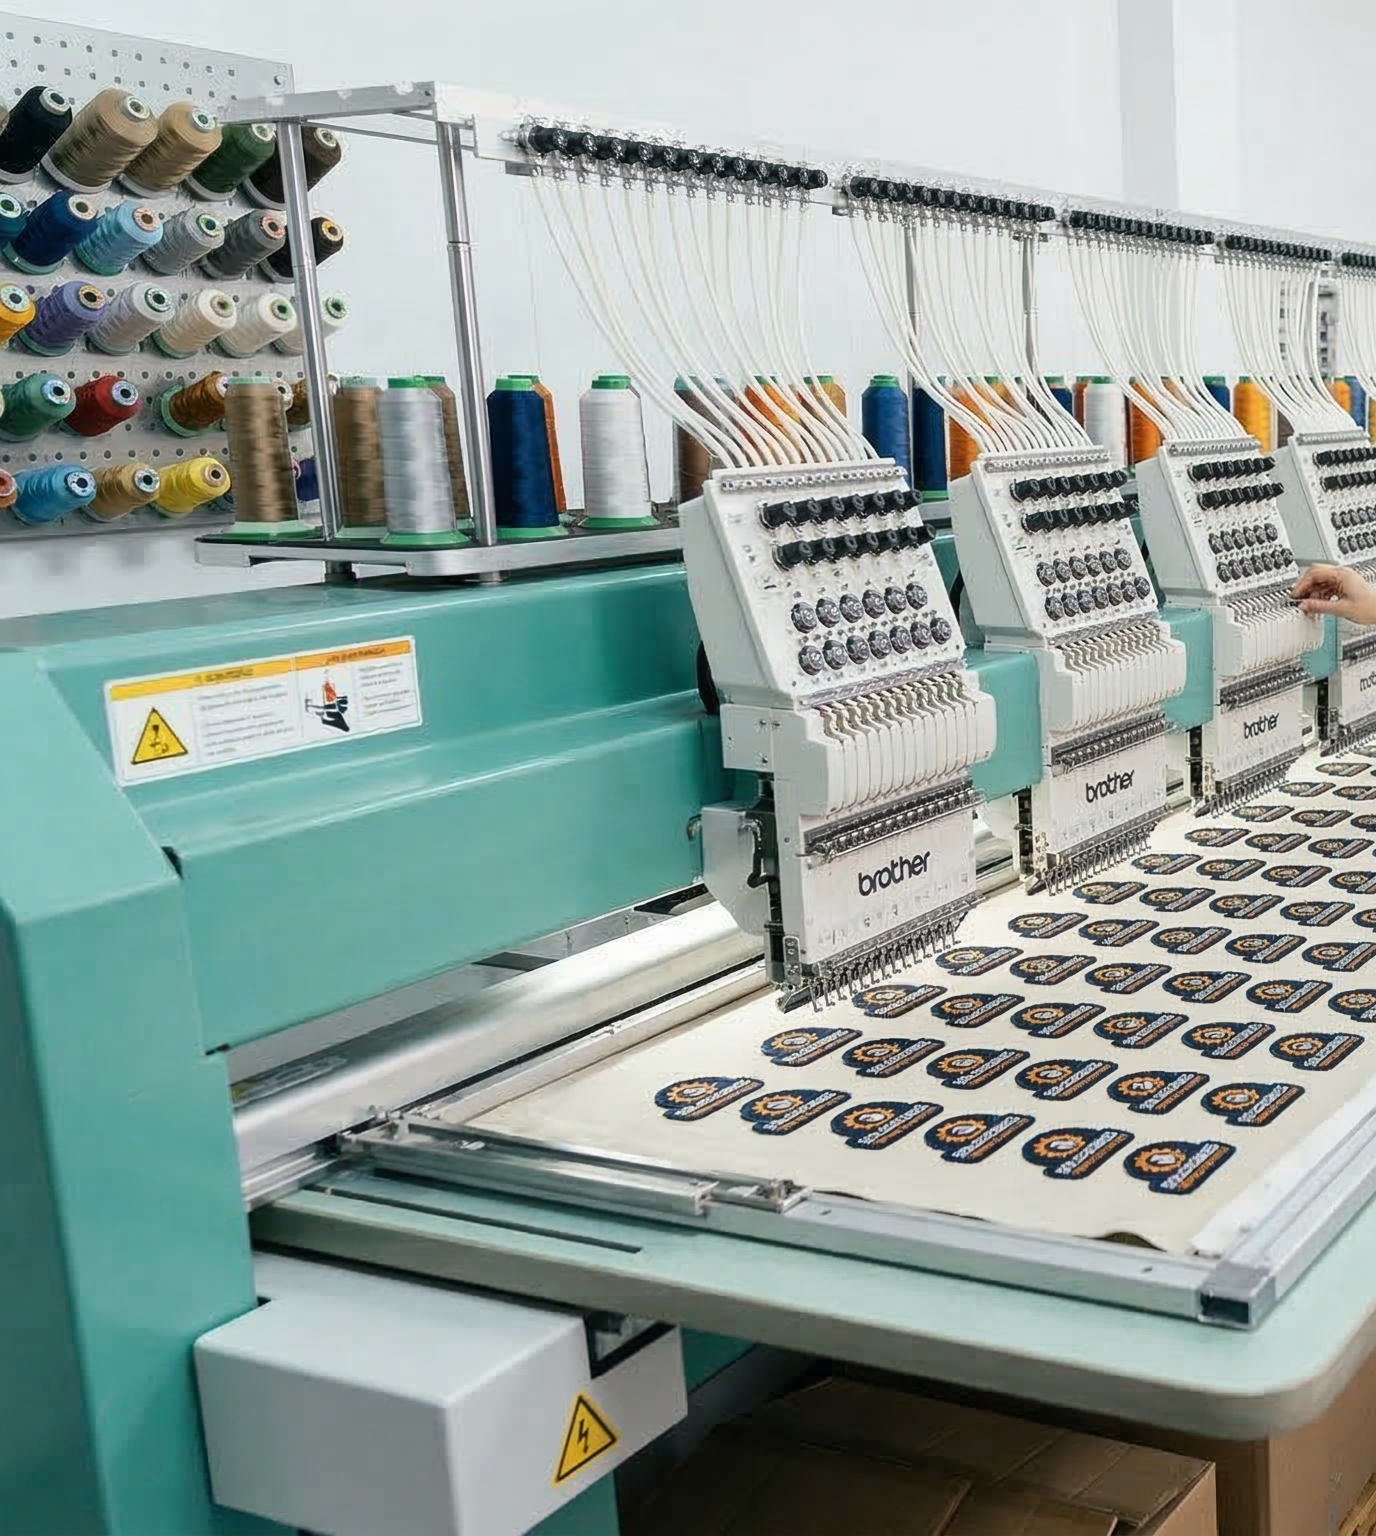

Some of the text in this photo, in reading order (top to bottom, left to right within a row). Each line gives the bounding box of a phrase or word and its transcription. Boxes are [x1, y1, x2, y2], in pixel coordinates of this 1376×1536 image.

[1243, 713, 1280, 739] brother
[1085, 769, 1135, 803] brother
[858, 851, 931, 897] brother
